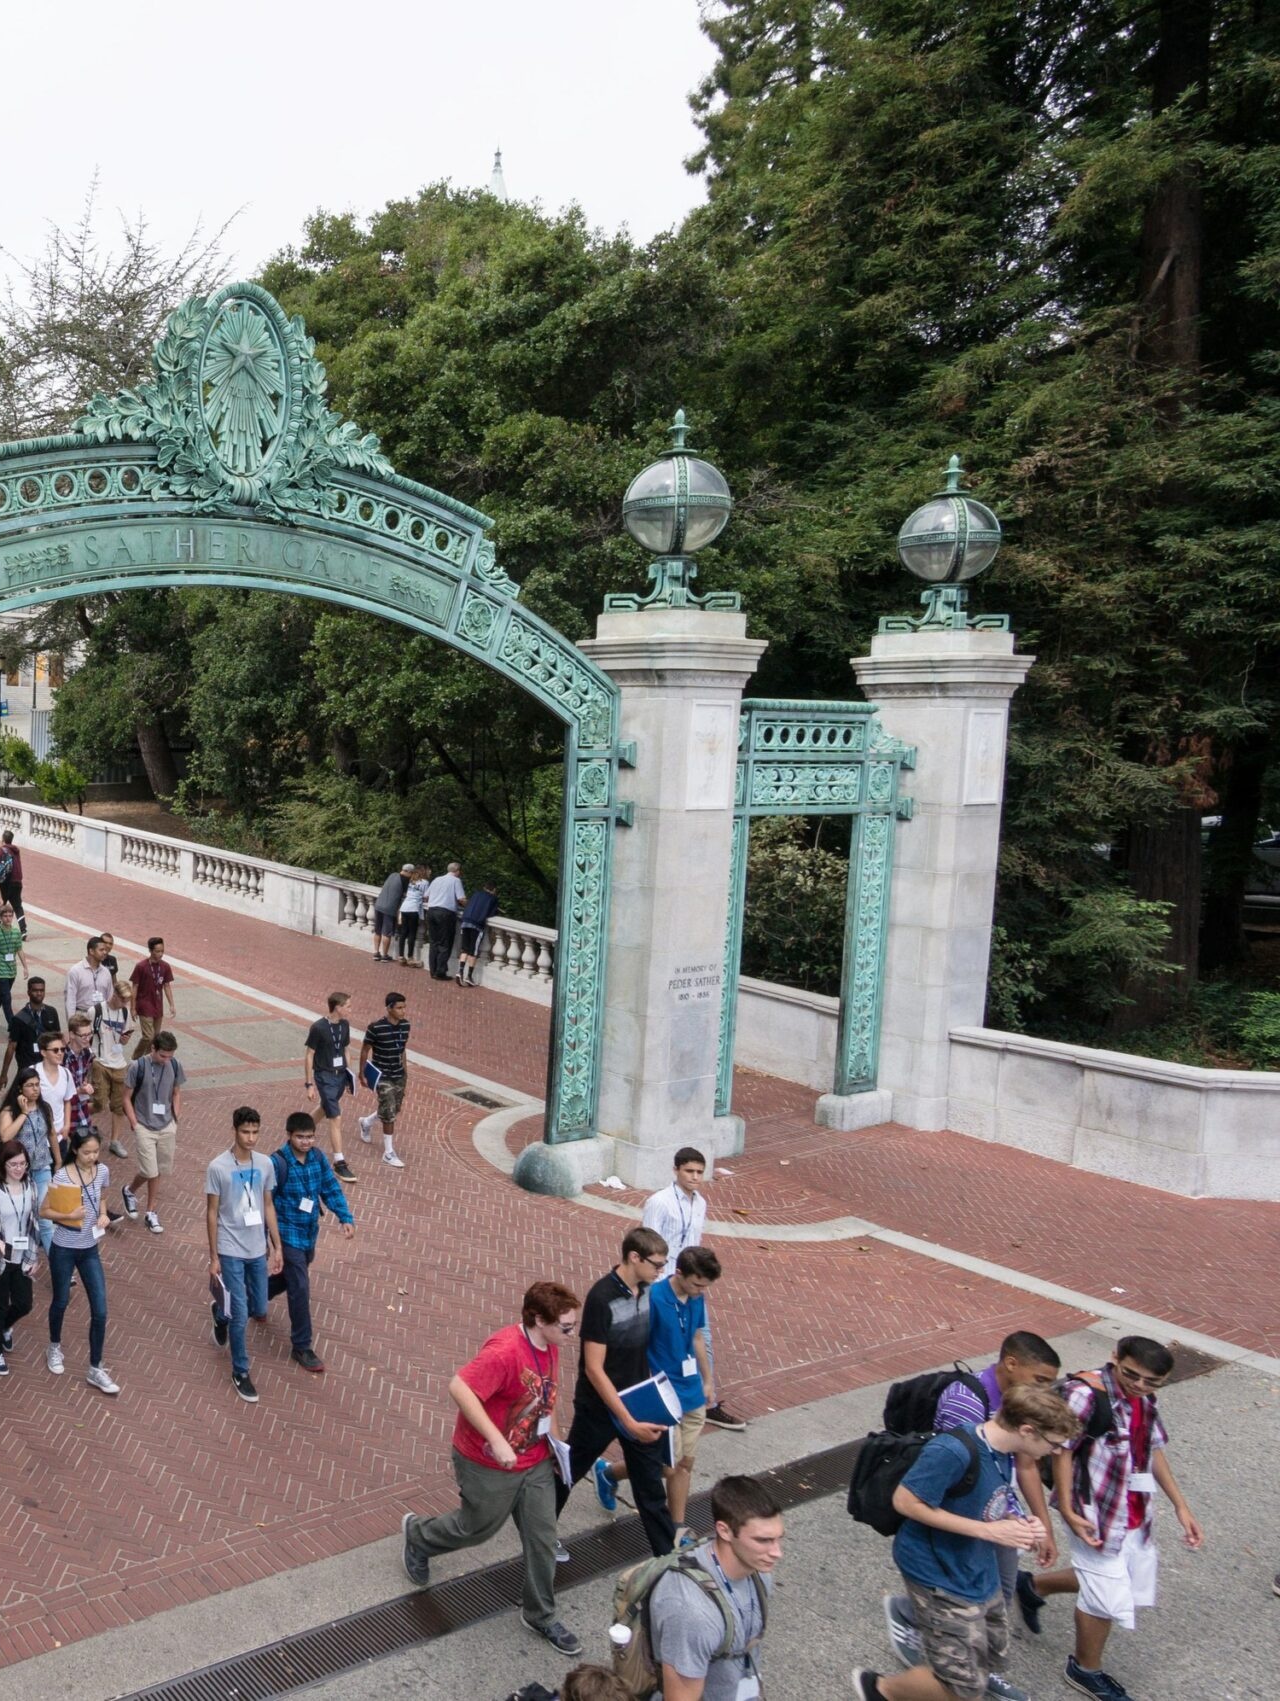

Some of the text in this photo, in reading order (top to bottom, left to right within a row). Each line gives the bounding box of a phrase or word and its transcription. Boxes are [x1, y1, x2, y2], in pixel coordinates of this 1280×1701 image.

[84, 529, 384, 590] SATHER GATE
[668, 976, 721, 990] PEDER SATHER
